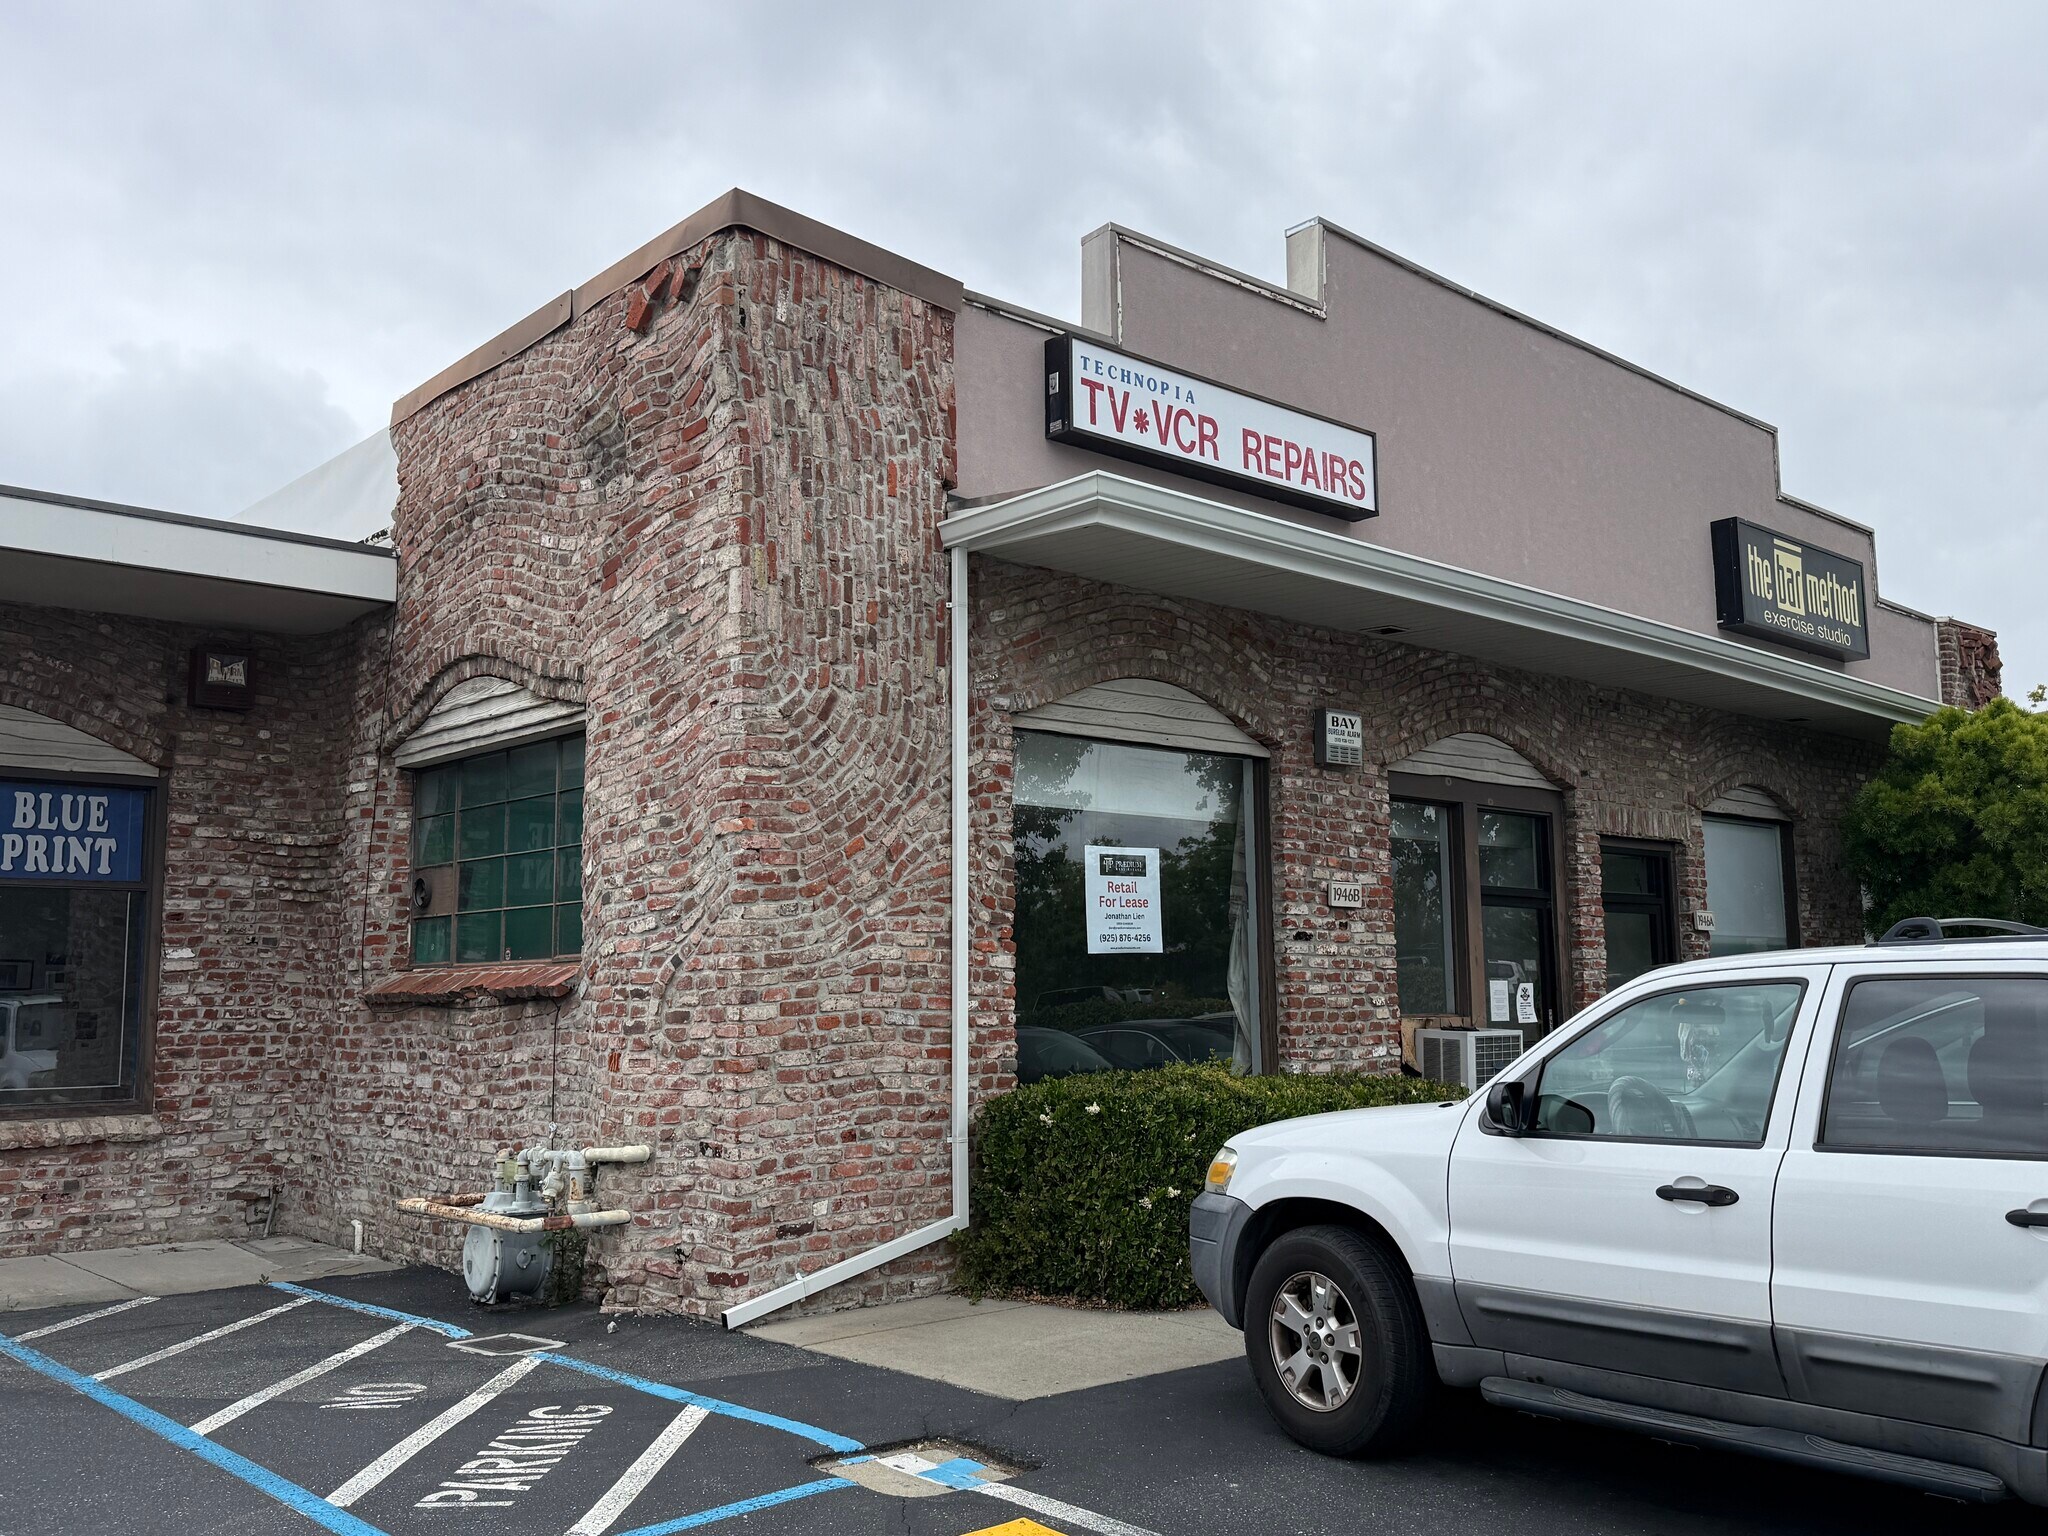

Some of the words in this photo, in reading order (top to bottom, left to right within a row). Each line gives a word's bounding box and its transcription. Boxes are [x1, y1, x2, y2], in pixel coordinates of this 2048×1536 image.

[1080, 355, 1196, 405] TECHNOPIA
[1241, 427, 1366, 501] REPAIRS
[1747, 543, 1773, 601] the
[1775, 553, 1802, 610] bar
[1806, 571, 1860, 628] method
[1764, 609, 1815, 636] exercise
[1817, 622, 1851, 647] studio
[1331, 715, 1357, 730] BAY
[1347, 730, 1361, 739] ALARM
[12, 791, 109, 833] BLUE
[0, 833, 117, 875] PRINT
[1107, 881, 1138, 894] Retail
[1333, 887, 1360, 903] 1946B
[1099, 895, 1117, 908] For
[1119, 896, 1149, 909] Lease
[1104, 912, 1132, 920] Jonathan
[1132, 912, 1145, 920] Lien
[1698, 915, 1714, 926] 1946A
[1099, 933, 1118, 943] (925)
[1119, 933, 1152, 943] 876-4256
[319, 1382, 427, 1409] NO
[413, 1404, 614, 1507] PARKING
